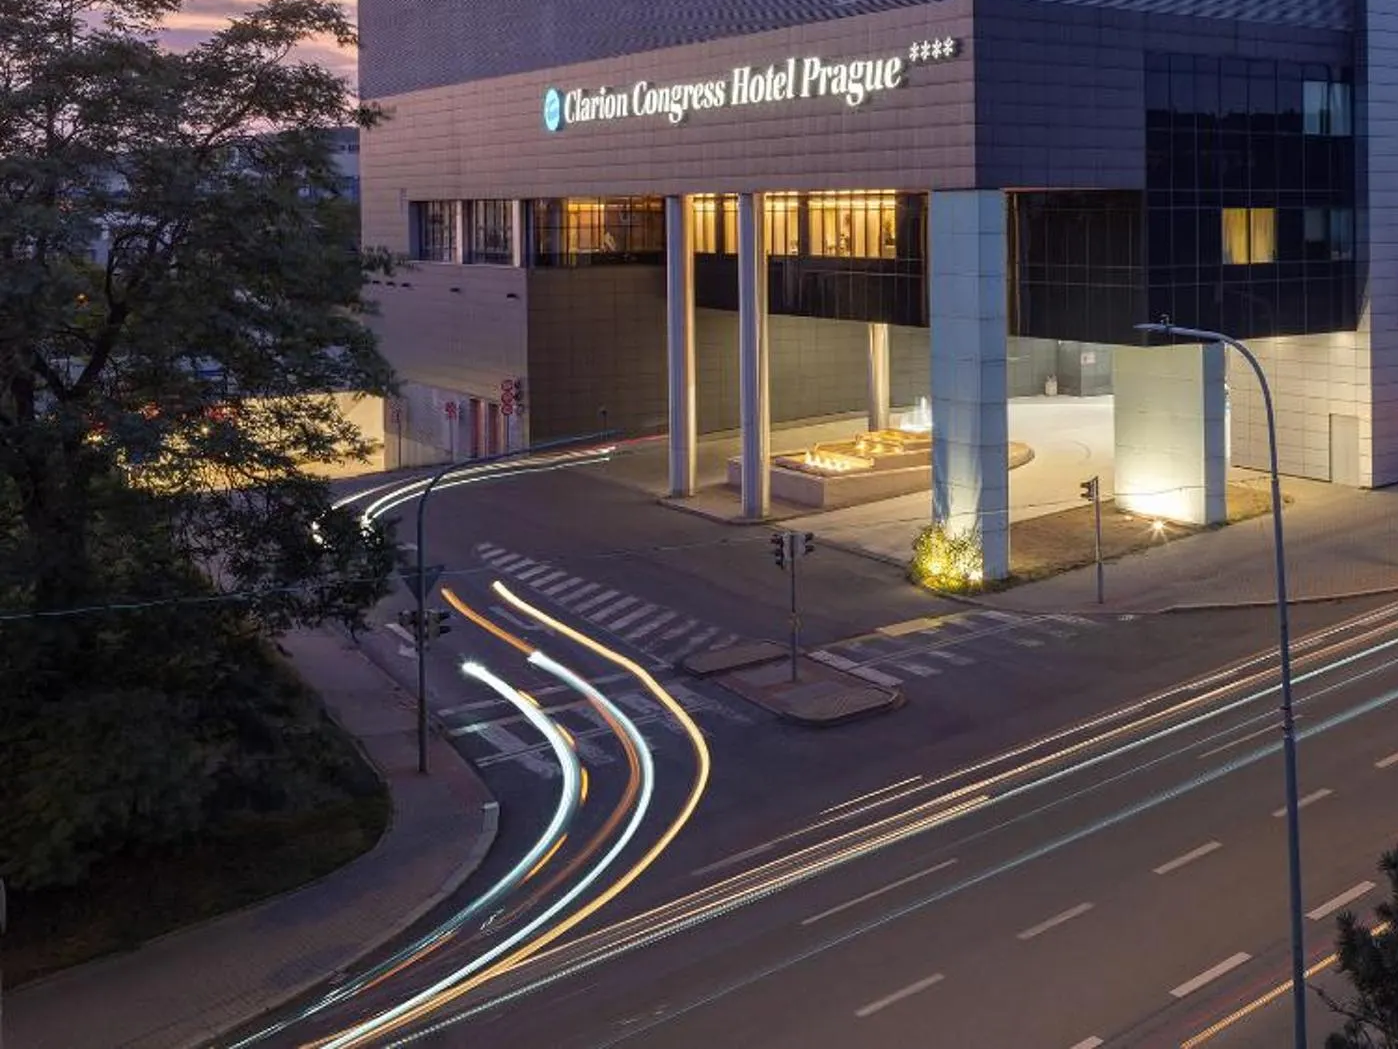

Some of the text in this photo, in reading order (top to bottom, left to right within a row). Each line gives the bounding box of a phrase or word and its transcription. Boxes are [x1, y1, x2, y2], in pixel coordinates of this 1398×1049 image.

[564, 56, 902, 124] Clarion Congress Hotel Prague
